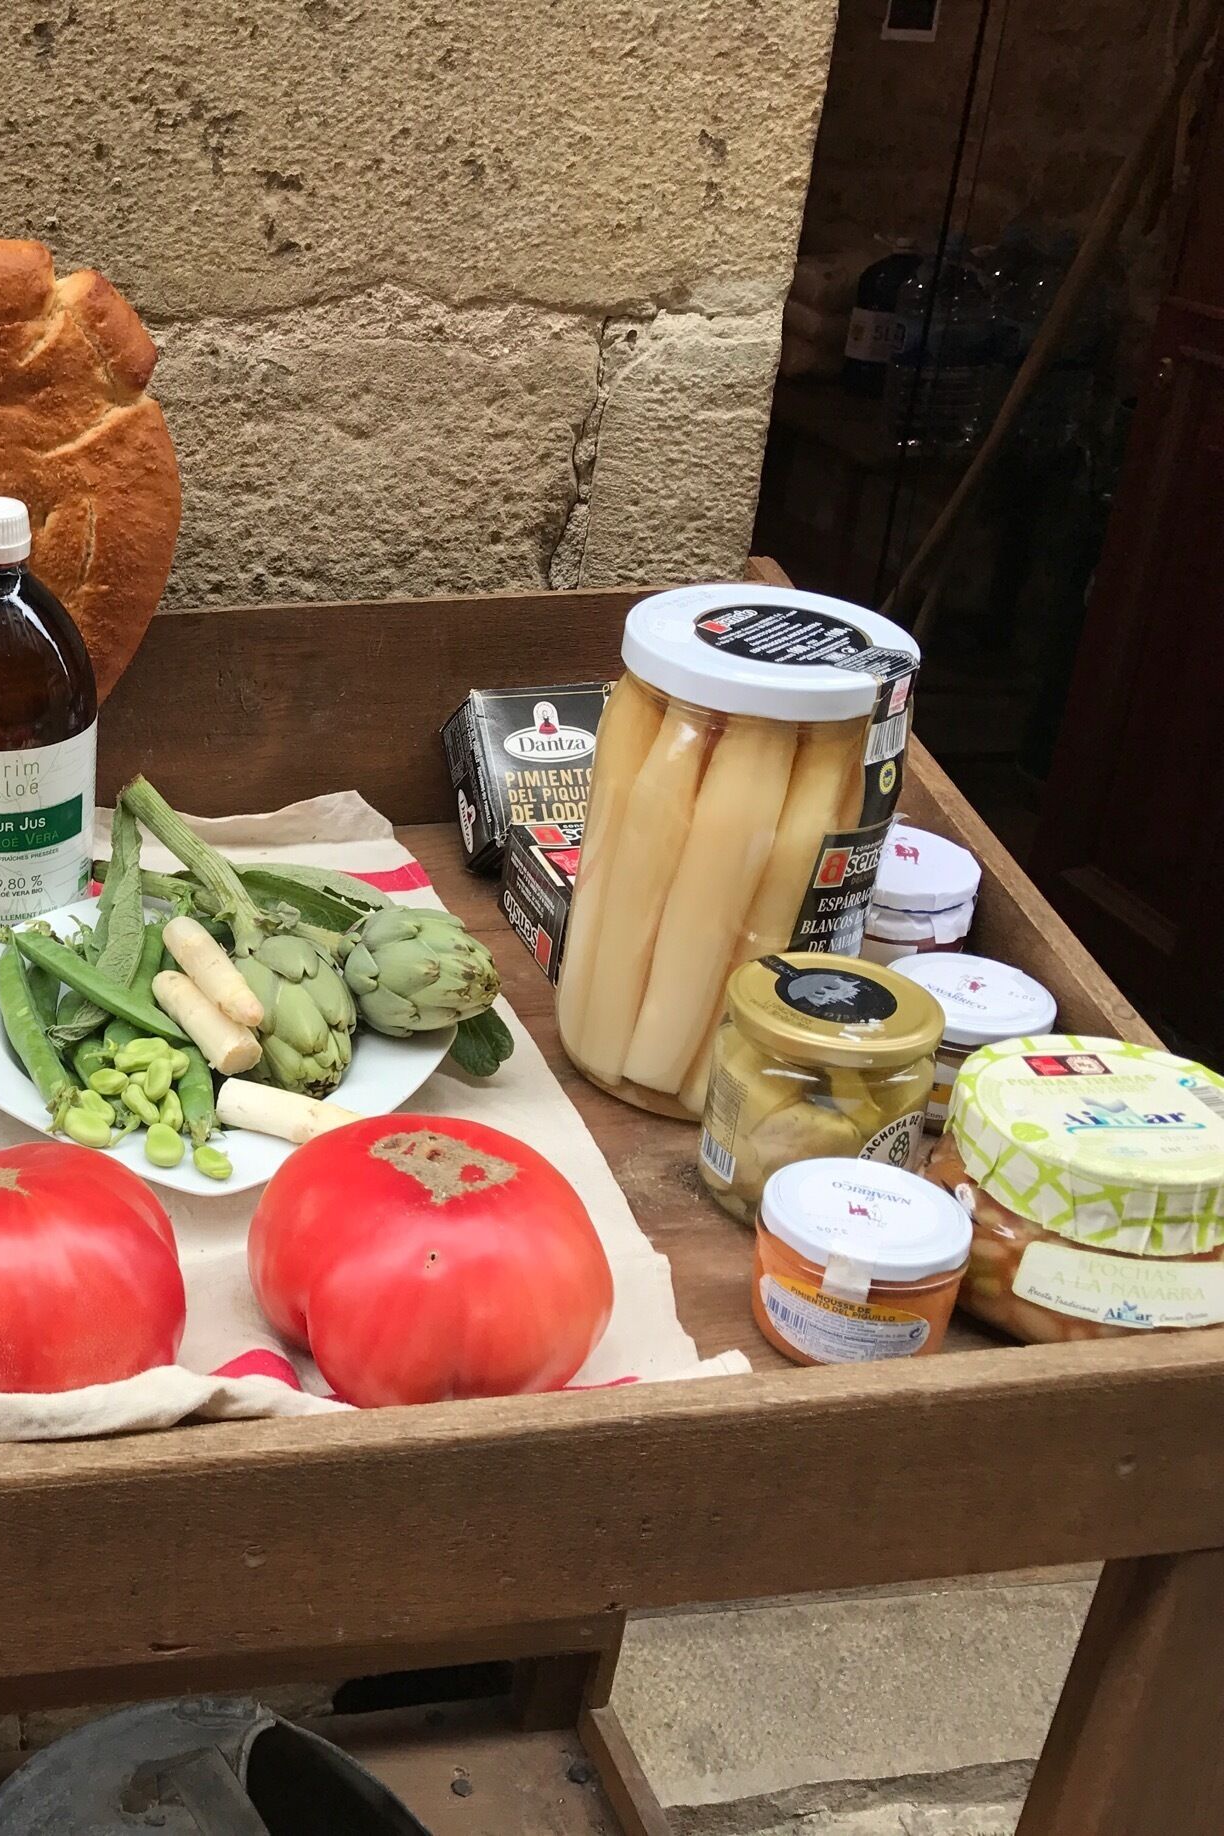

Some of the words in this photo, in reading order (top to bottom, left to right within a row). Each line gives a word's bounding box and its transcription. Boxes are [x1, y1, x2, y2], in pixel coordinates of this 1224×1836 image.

[518, 736, 587, 754] Dantza
[508, 788, 537, 803] DEL
[511, 804, 537, 823] DE
[31, 874, 43, 887] %
[12, 889, 30, 897] VERA
[31, 887, 43, 895] BIO
[800, 915, 853, 934] BLANCOS
[832, 1181, 912, 1206] NAVARRICO
[1087, 1259, 1178, 1283] POCHAS
[1051, 1270, 1065, 1285] A
[1073, 1275, 1102, 1294] LA
[1110, 1282, 1206, 1301] NAVARRA
[790, 1286, 830, 1309] PIMIENTO
[832, 1306, 849, 1316] DEL
[816, 1292, 856, 1310] MOUSSE
[857, 1306, 872, 1314] DE
